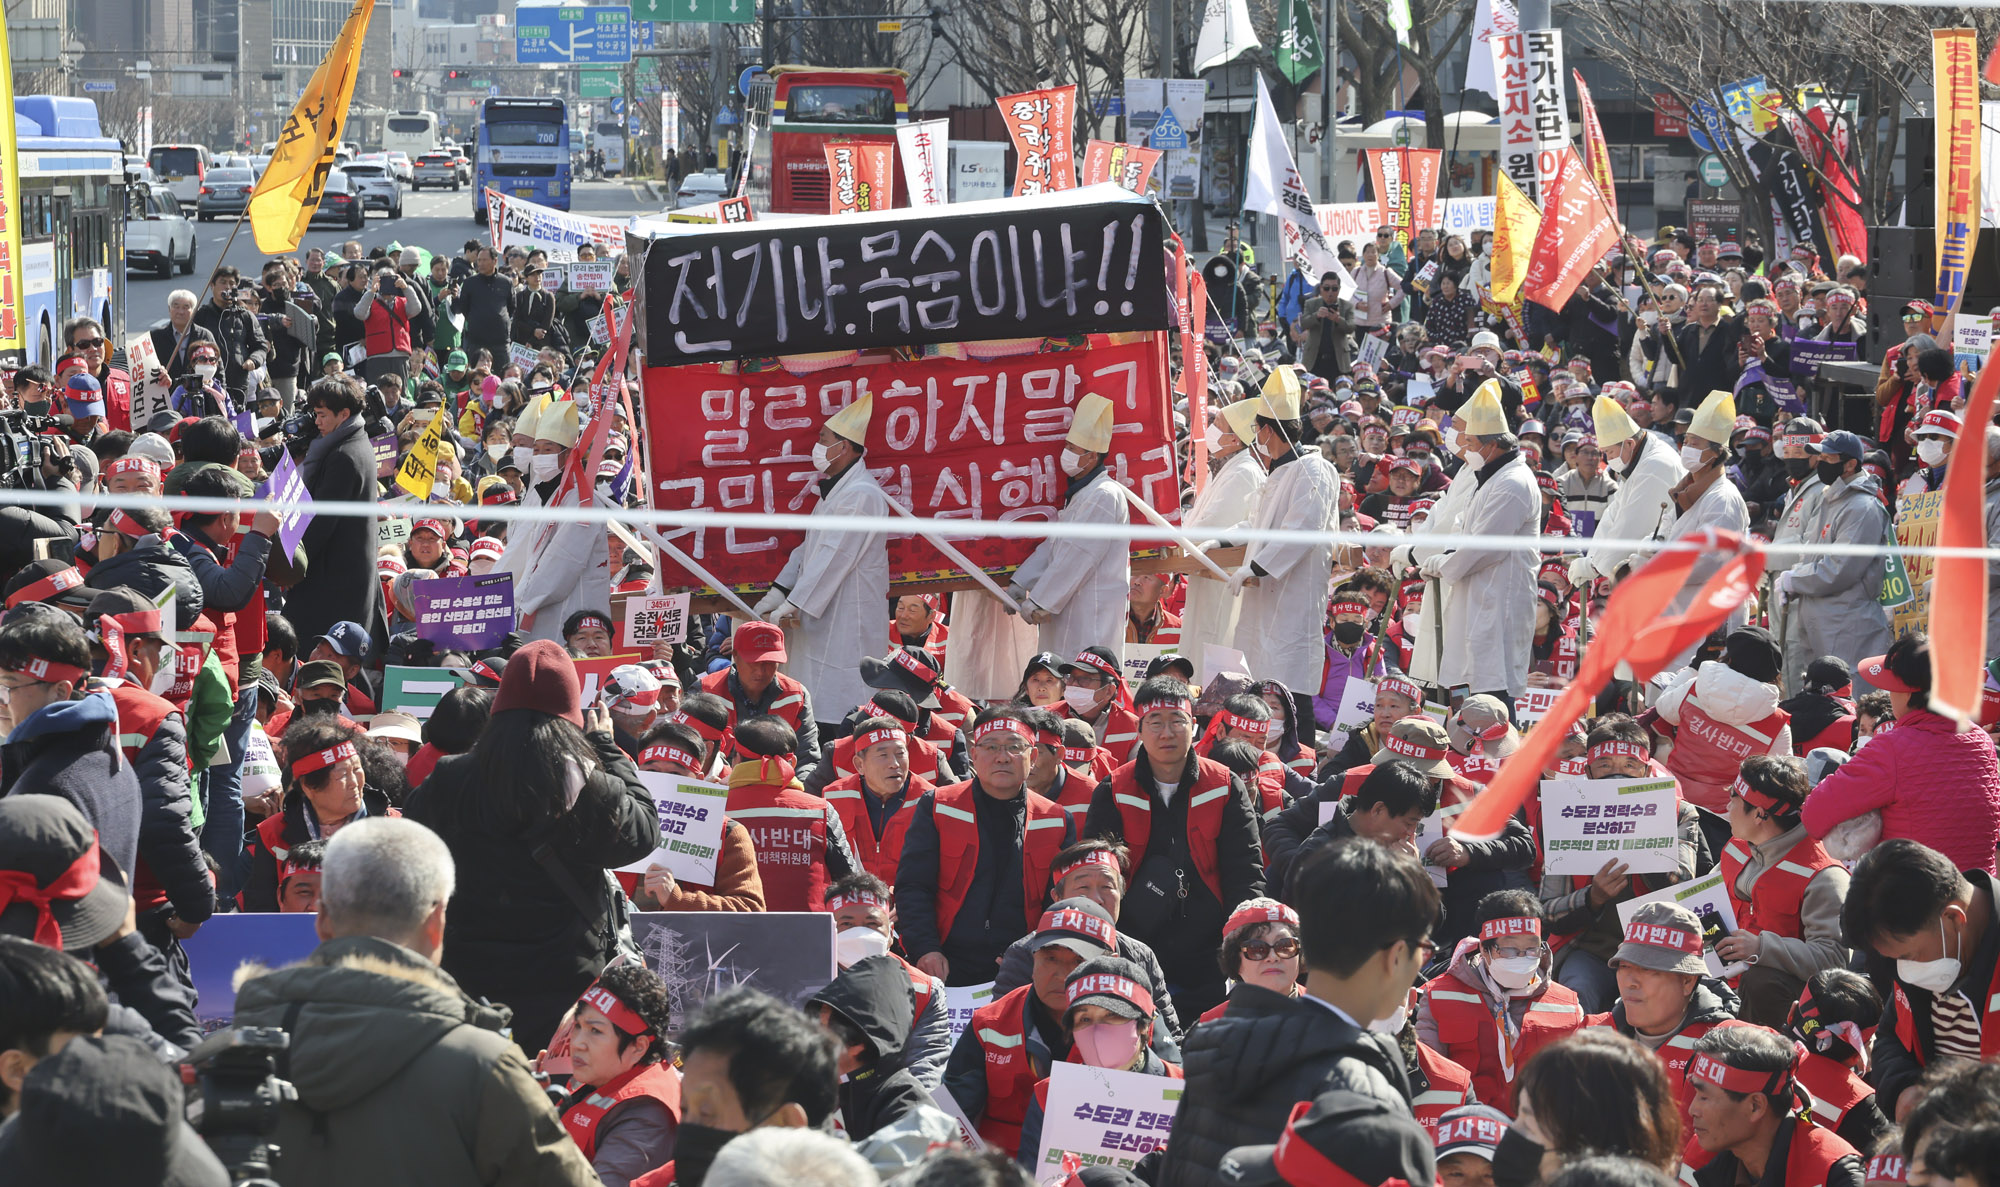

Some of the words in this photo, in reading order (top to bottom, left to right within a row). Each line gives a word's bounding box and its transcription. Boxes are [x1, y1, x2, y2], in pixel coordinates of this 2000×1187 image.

[523, 39, 546, 47] 소공로
[1498, 34, 1533, 144] 지산지소
[1529, 33, 1563, 142] 국가산단
[538, 133, 554, 143] 700
[573, 264, 587, 272] 우리
[129, 344, 146, 420] 투쟁한다!
[430, 598, 451, 610] 주민
[453, 595, 482, 608] 수용성
[484, 594, 503, 605] 없는
[1332, 603, 1362, 615] 결사반대
[475, 606, 512, 620] 송전선로
[452, 622, 487, 635] 무효다!
[633, 625, 657, 639] 건설
[661, 623, 680, 638] 반대
[1124, 659, 1149, 668] 수도권
[1379, 679, 1419, 699] 결사반대
[1142, 698, 1186, 714] 결사반대
[976, 719, 1018, 738] 결사반대
[1230, 714, 1267, 733] 결사반대
[1687, 714, 1751, 758] 결사반대
[644, 746, 692, 767] 결사반대
[1387, 737, 1427, 758] 결사반대
[1594, 742, 1641, 758] 결사반대
[658, 800, 709, 823] 전력수요
[1561, 805, 1601, 818] 수도권
[1603, 803, 1658, 818] 전력수요
[1582, 821, 1636, 835] 분산하고
[1548, 839, 1594, 851] 민주적인
[1596, 839, 1620, 851] 절차
[1622, 836, 1675, 851] 마련하라!
[1050, 911, 1111, 943] 결사반대
[1484, 918, 1537, 938] 결사반대
[1625, 924, 1685, 948] 결사반대
[1066, 973, 1135, 1000] 결사반대
[1073, 1102, 1135, 1126] 수도권
